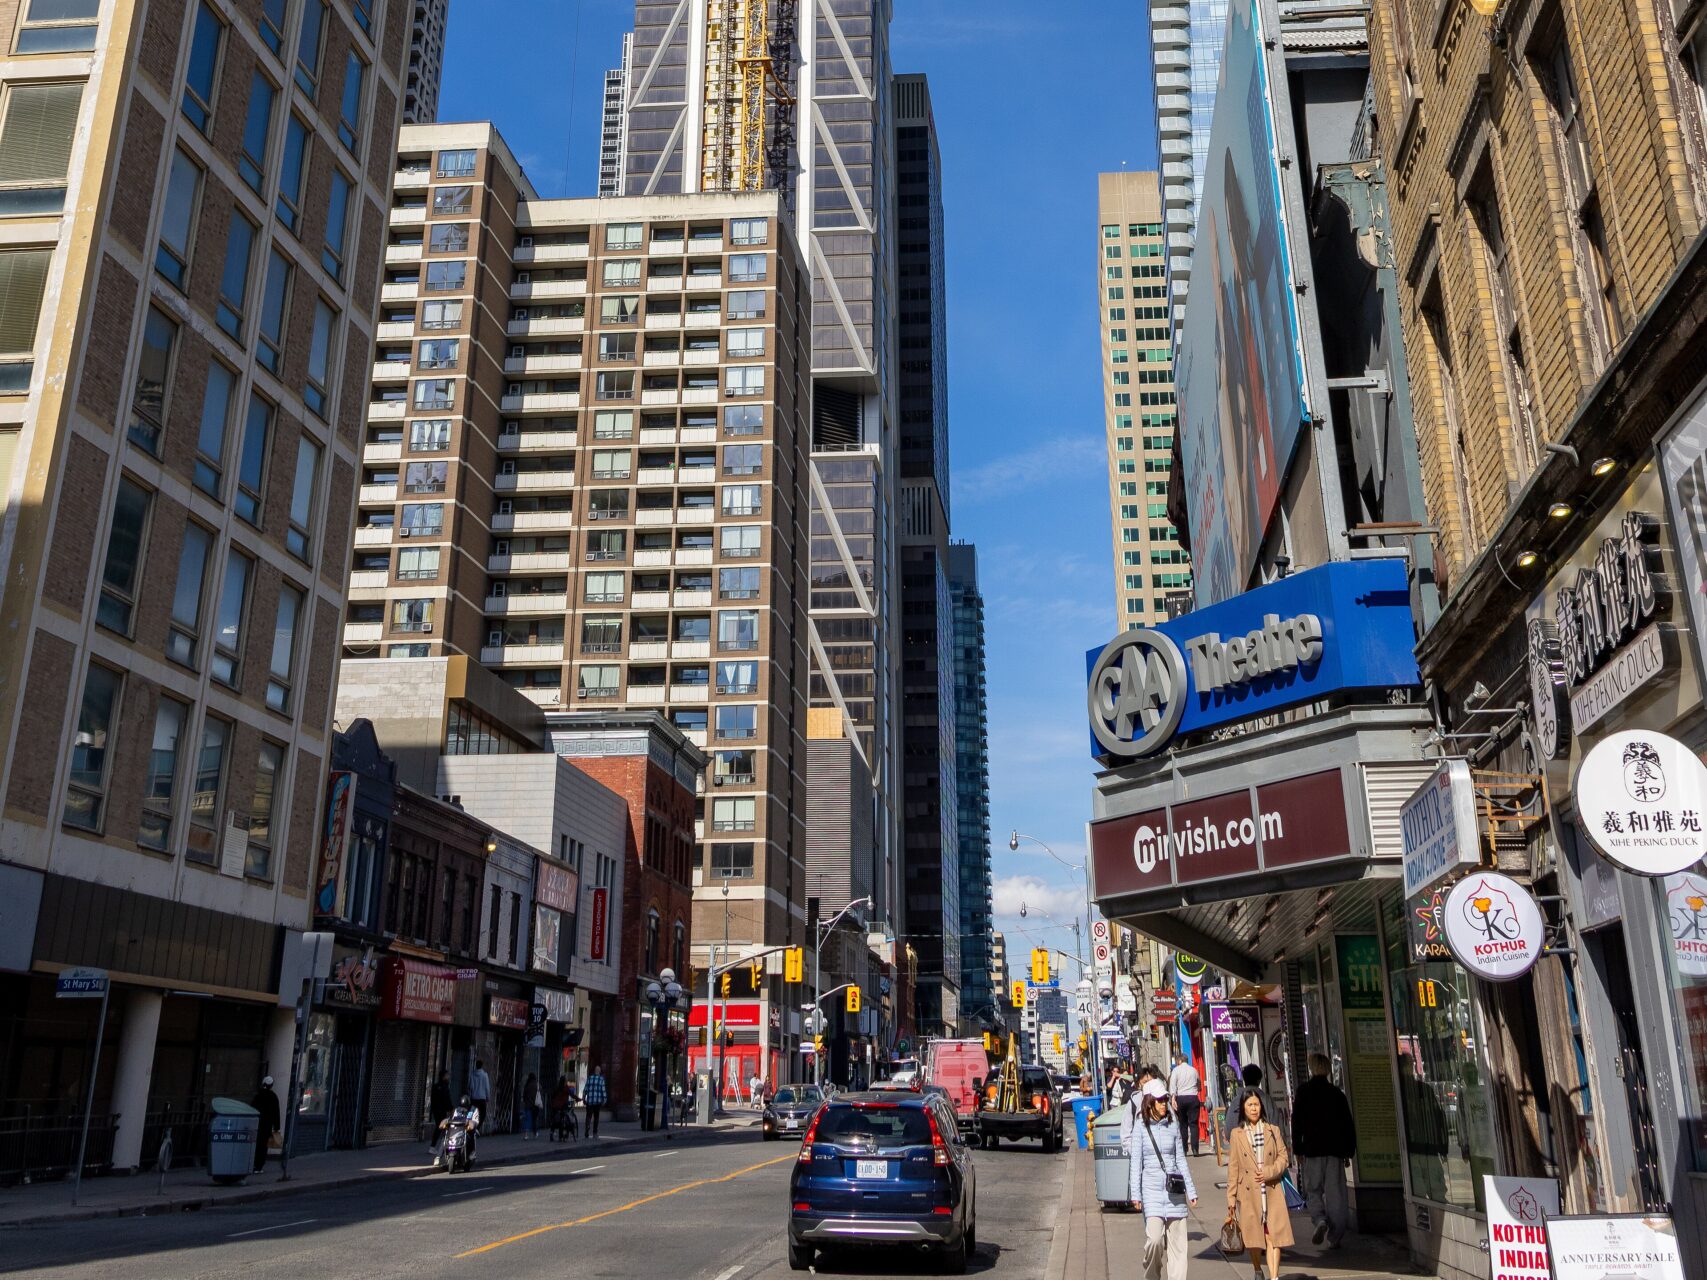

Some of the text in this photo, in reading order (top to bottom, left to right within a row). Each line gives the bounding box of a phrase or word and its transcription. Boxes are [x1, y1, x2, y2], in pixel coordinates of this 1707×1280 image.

[1097, 613, 1324, 740] CAA Theatre
[1575, 631, 1659, 729] XIHE PEKING DUCK
[1401, 786, 1444, 857] KOTHUR
[1137, 811, 1284, 866] mirvish.com
[1609, 836, 1699, 848] XIHE PEKING DUCK
[1405, 850, 1426, 890] INDIAN
[1415, 943, 1451, 957] KARA
[1474, 940, 1527, 956] KOTHUR
[1477, 951, 1530, 965] Indian Cuisine
[63, 980, 98, 991] St Mary St
[405, 972, 430, 998] METRO
[432, 979, 454, 1002] CIGAR
[532, 1007, 543, 1015] TOP
[1106, 1148, 1119, 1157] Litter
[1560, 1252, 1675, 1264] ANNIVERSARY SALE
